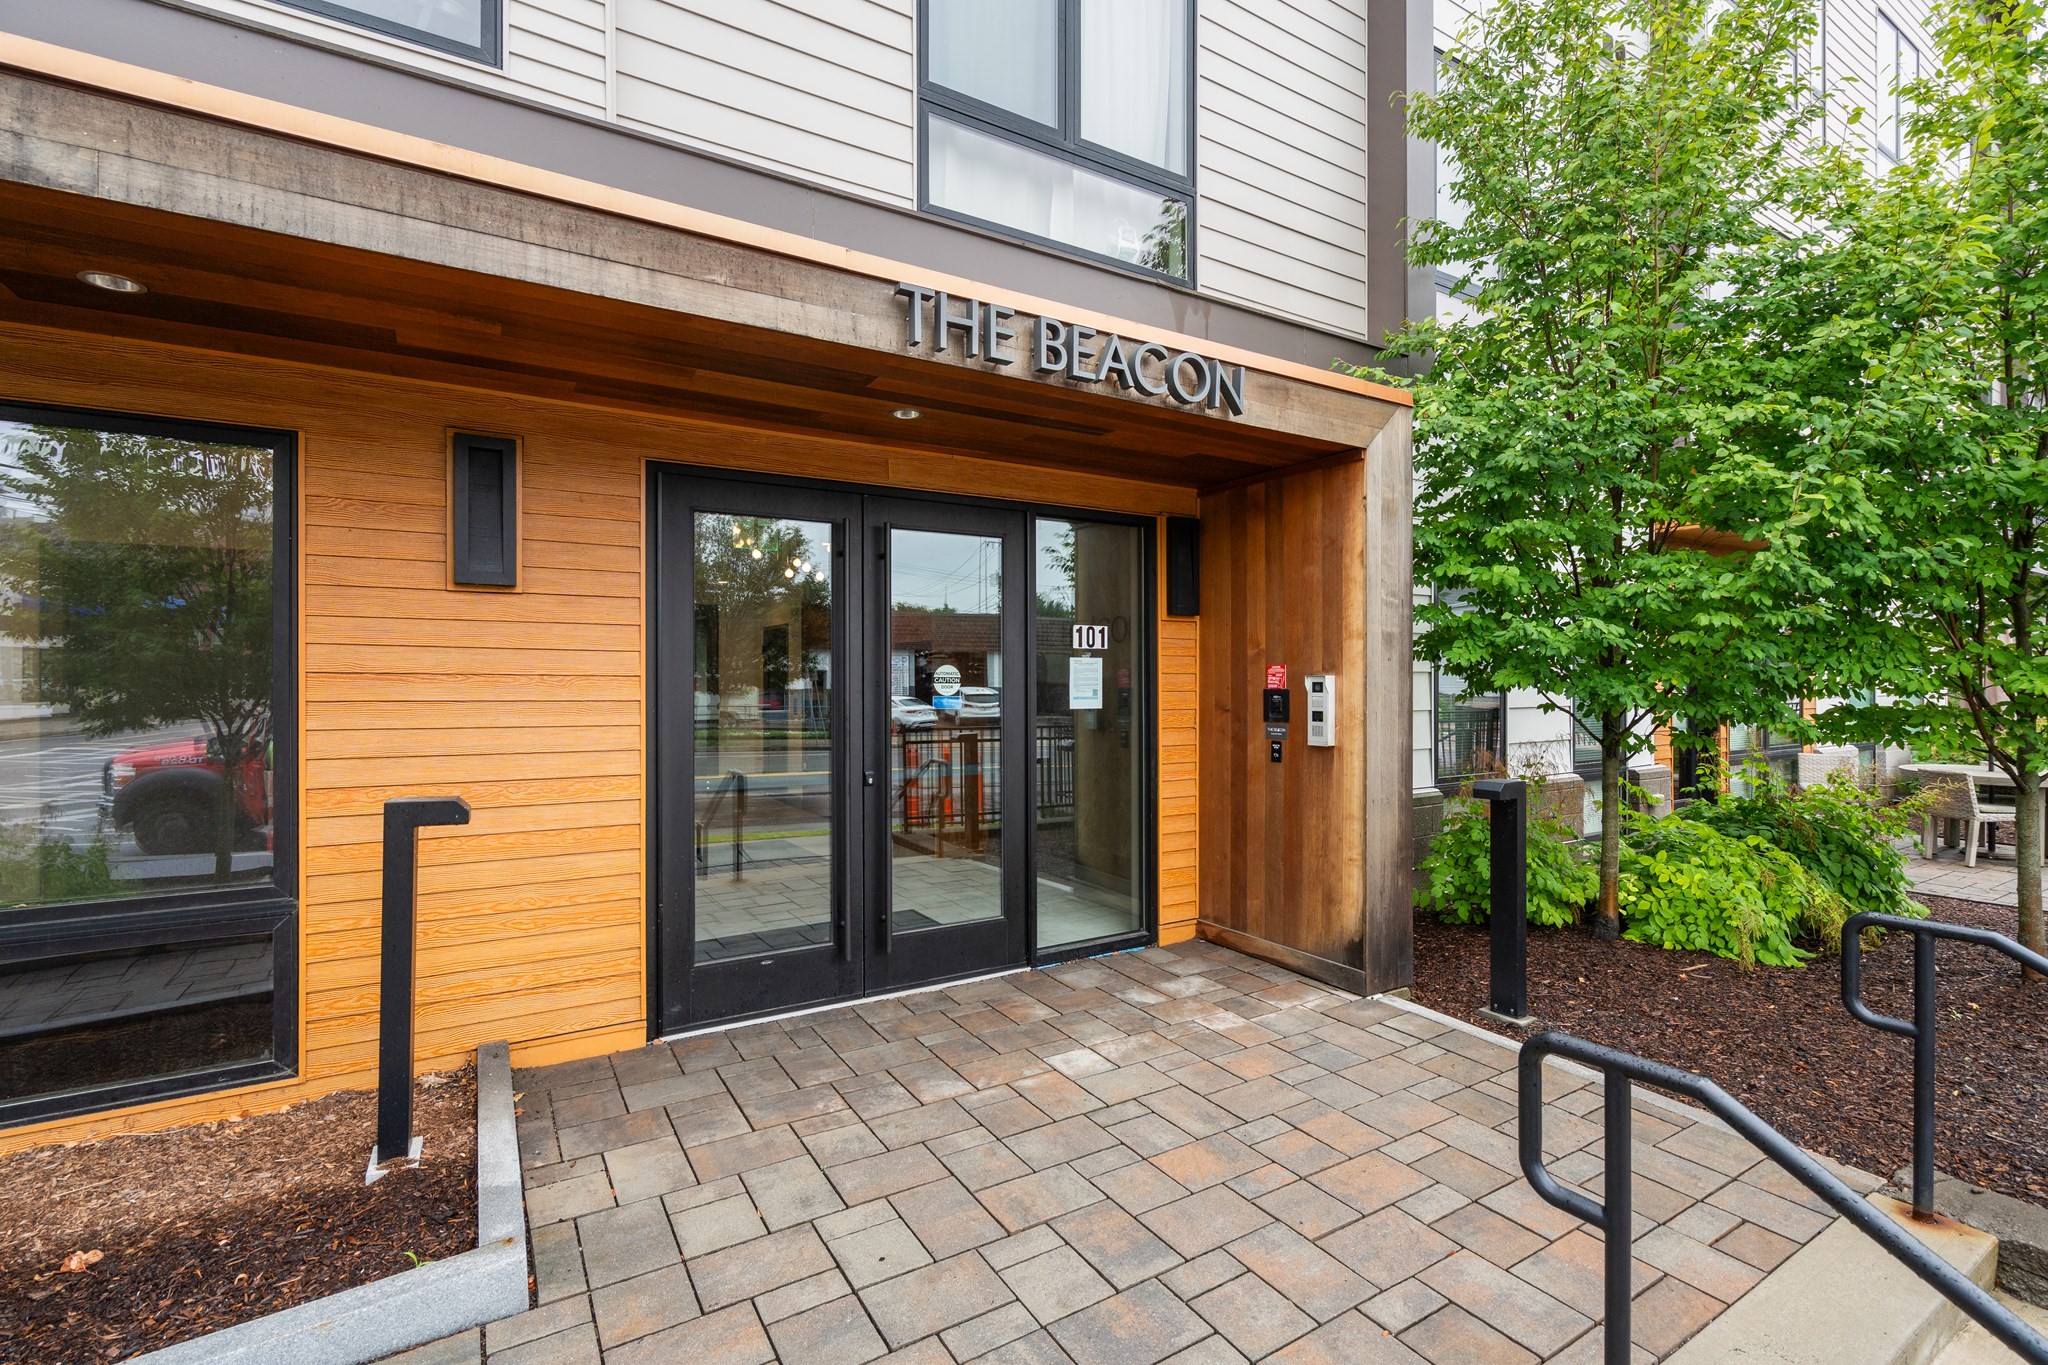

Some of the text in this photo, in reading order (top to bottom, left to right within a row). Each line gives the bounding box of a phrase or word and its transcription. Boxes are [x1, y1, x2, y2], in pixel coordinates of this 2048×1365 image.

[894, 281, 1246, 417] THE BEACON
[1076, 626, 1105, 648] 101
